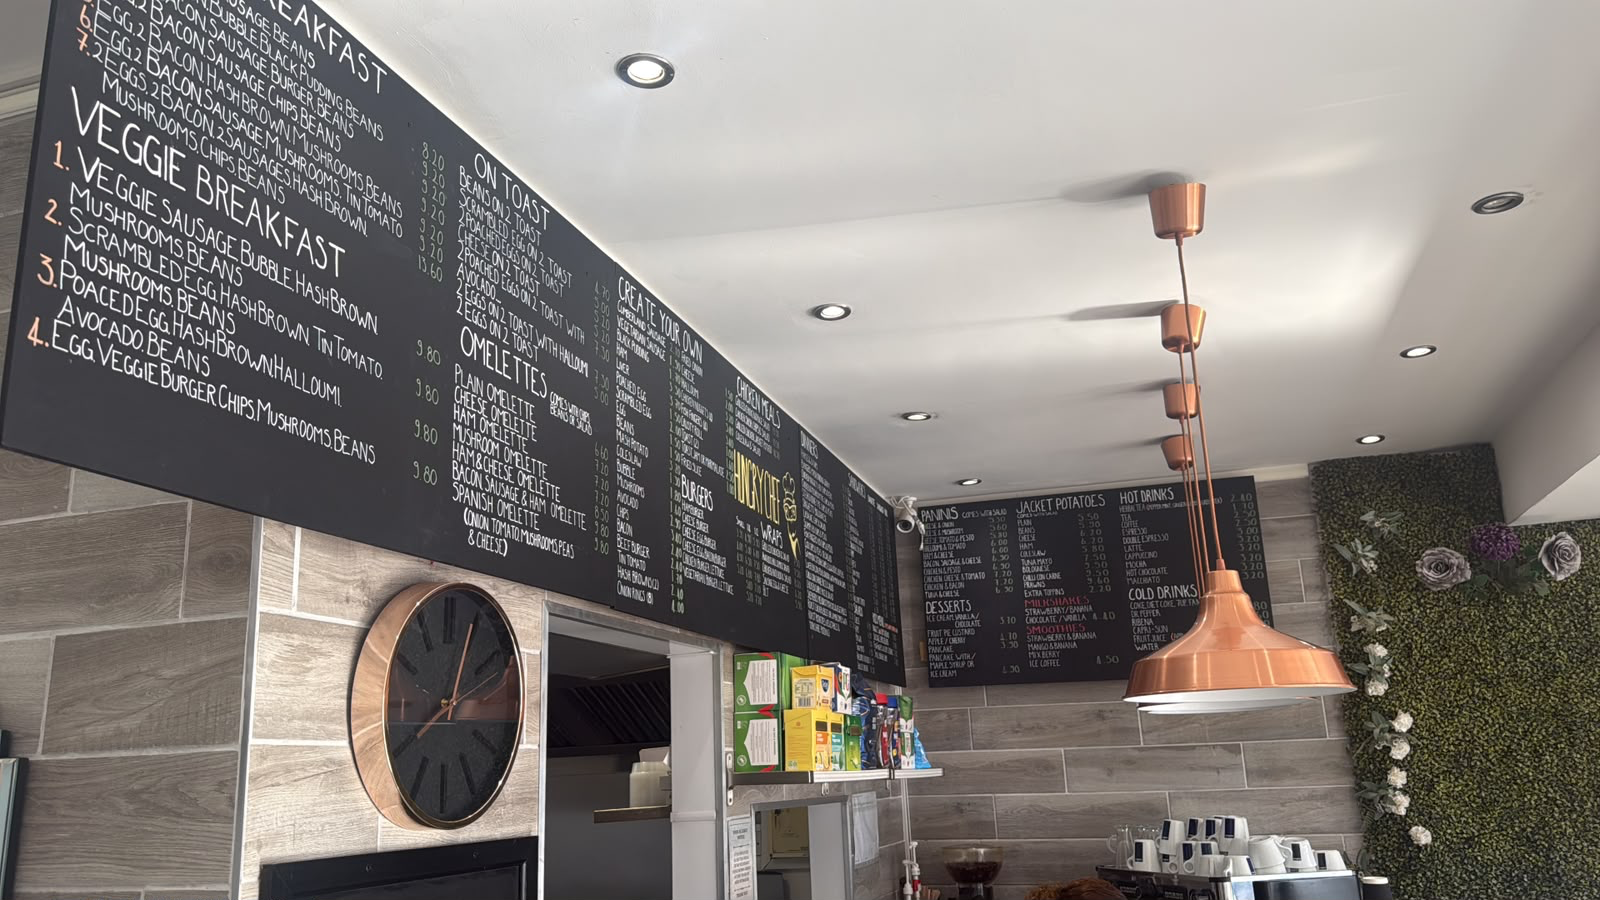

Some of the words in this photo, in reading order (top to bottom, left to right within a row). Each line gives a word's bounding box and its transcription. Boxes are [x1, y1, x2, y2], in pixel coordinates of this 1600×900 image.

[422, 142, 444, 171] 8.20
[71, 86, 186, 191] VEGGIE
[196, 163, 346, 278] BREAKFAST
[77, 146, 157, 217] VEGGIE
[474, 153, 497, 190] ON
[501, 172, 550, 230] TOAST
[459, 165, 490, 207] BEANS
[492, 196, 504, 220] ON
[505, 206, 511, 225] 2
[514, 212, 542, 246] TOAST
[458, 188, 508, 239] SCRAMBLED
[511, 229, 526, 253] EGG
[527, 243, 538, 262] ON
[539, 252, 545, 267] 2
[547, 257, 572, 289] TOAST
[187, 241, 243, 287] BEANS
[418, 255, 443, 282] 13.60
[492, 251, 504, 272] ON
[505, 260, 511, 276] 2
[513, 264, 540, 297] TOAST
[177, 288, 236, 335] BEANS
[456, 295, 463, 316] 2
[464, 302, 487, 330] EGGS
[489, 319, 501, 338] ON
[502, 326, 509, 345] 2
[512, 331, 539, 362] TOAST
[618, 276, 657, 328] CREATE
[659, 309, 681, 347] YOUR
[682, 330, 703, 364] OWN
[146, 330, 211, 377] BEANS
[416, 339, 441, 366] 9.80
[461, 326, 547, 398] OMELETTES
[415, 378, 440, 405] 9.80
[454, 363, 484, 397] PLAIN
[487, 383, 535, 423] OMELETTE
[454, 386, 488, 418] CHEESE
[490, 404, 537, 441] OMELETTE
[414, 419, 438, 445] 9.80
[452, 423, 500, 458] MUSHROOM
[504, 446, 548, 481] OMELETTE
[453, 403, 476, 429] HAM
[479, 417, 528, 455] OMELETTE
[413, 460, 437, 486] 9.80
[452, 440, 475, 464] HAM
[483, 455, 514, 484] CHEESE
[517, 470, 560, 503] OMELETTE
[681, 474, 714, 512] BURGERS
[452, 482, 493, 513] SPANISH
[496, 499, 539, 530] OMELETTE
[484, 476, 519, 504] SAUSAGE
[529, 493, 546, 514] HAM
[550, 503, 586, 531] OMELETTE
[921, 506, 959, 522] PANINIS
[1016, 498, 1053, 514] JACKET
[1055, 494, 1106, 510] POTATOES
[1119, 490, 1139, 505] HOT
[1140, 487, 1175, 502] DRINKS
[760, 521, 783, 550] WRAPS
[926, 600, 972, 614] DESSERTS
[1024, 596, 1089, 608] MILKSHAKES
[1128, 588, 1155, 601] COLD
[1157, 584, 1197, 598] DRINKS
[1026, 624, 1086, 635] SMOOTHIES
